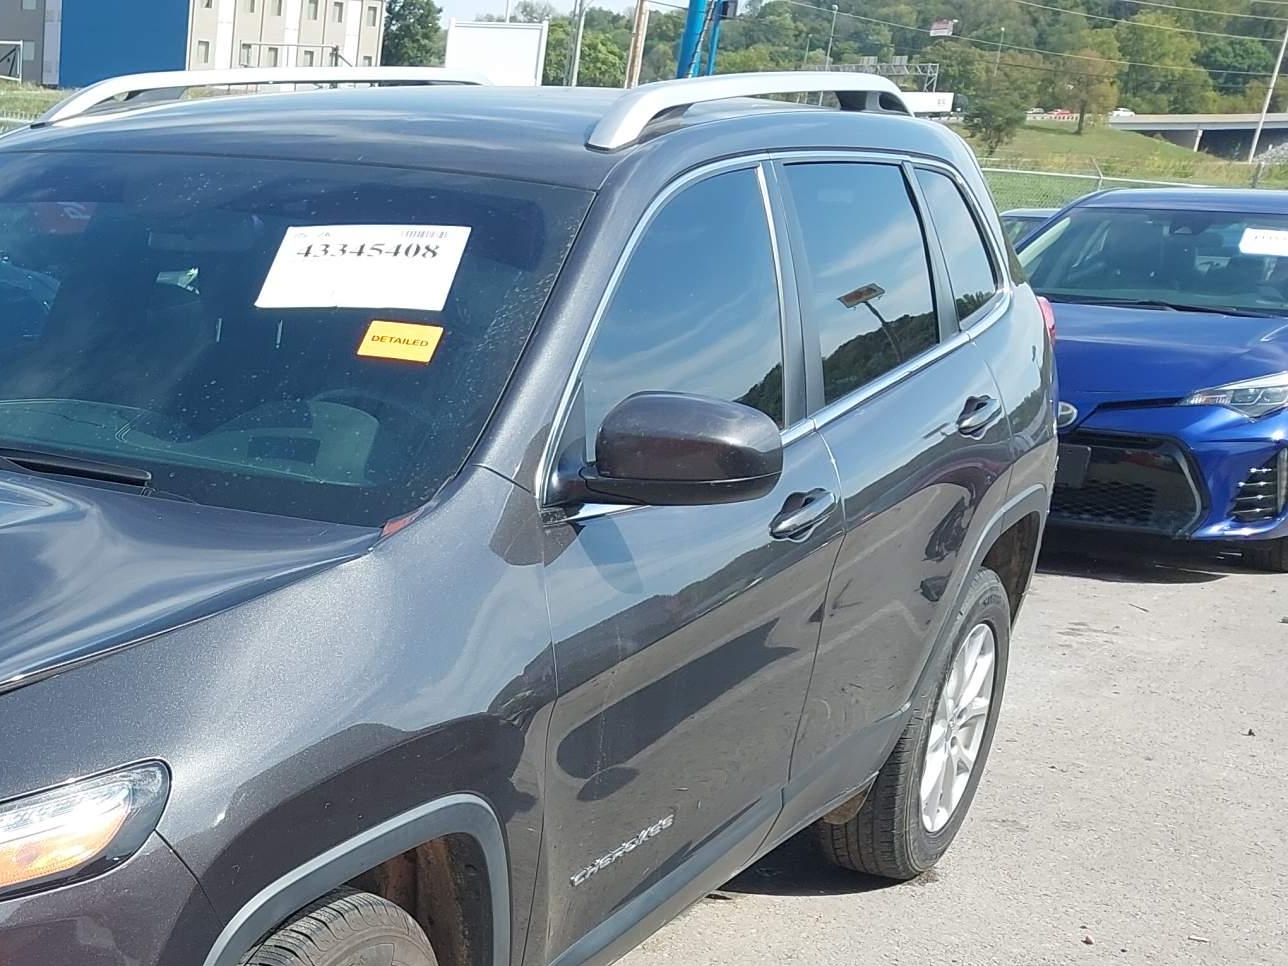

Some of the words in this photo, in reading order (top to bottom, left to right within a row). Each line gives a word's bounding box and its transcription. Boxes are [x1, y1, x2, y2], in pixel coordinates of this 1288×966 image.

[296, 242, 441, 258] 43345408
[370, 334, 429, 347] DETAILED
[570, 813, 675, 887] CHEROKEE
